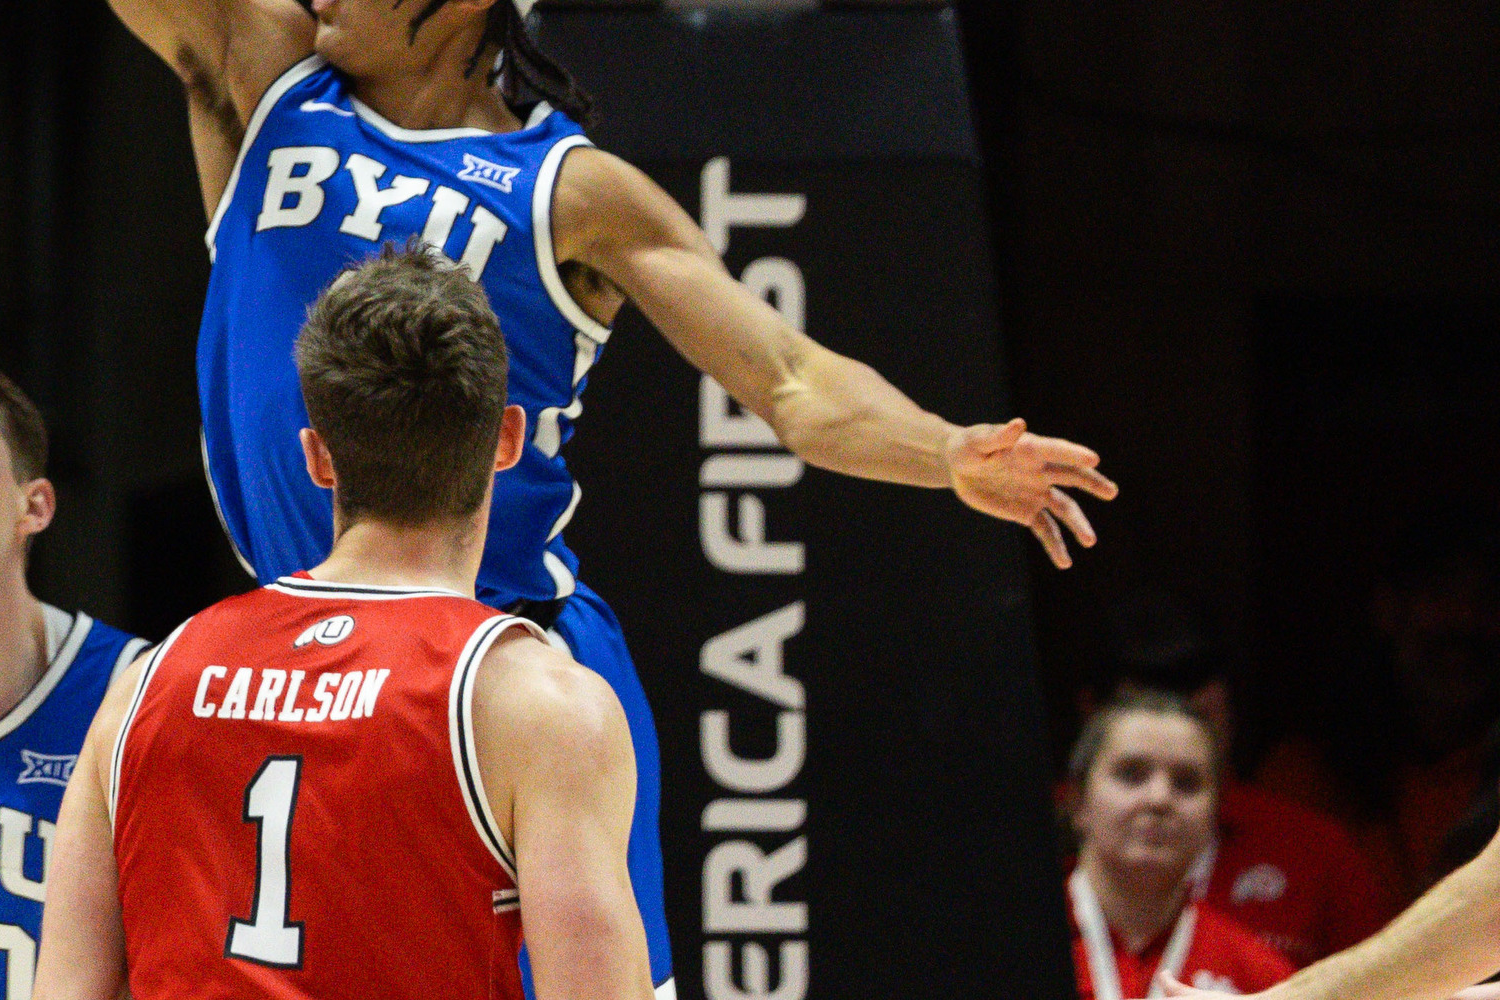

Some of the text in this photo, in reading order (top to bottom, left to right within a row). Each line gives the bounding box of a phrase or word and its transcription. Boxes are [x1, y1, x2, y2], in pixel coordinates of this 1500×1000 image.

[255, 146, 509, 284] BYU
[192, 665, 391, 722] CARLSON
[223, 754, 305, 970] 1
